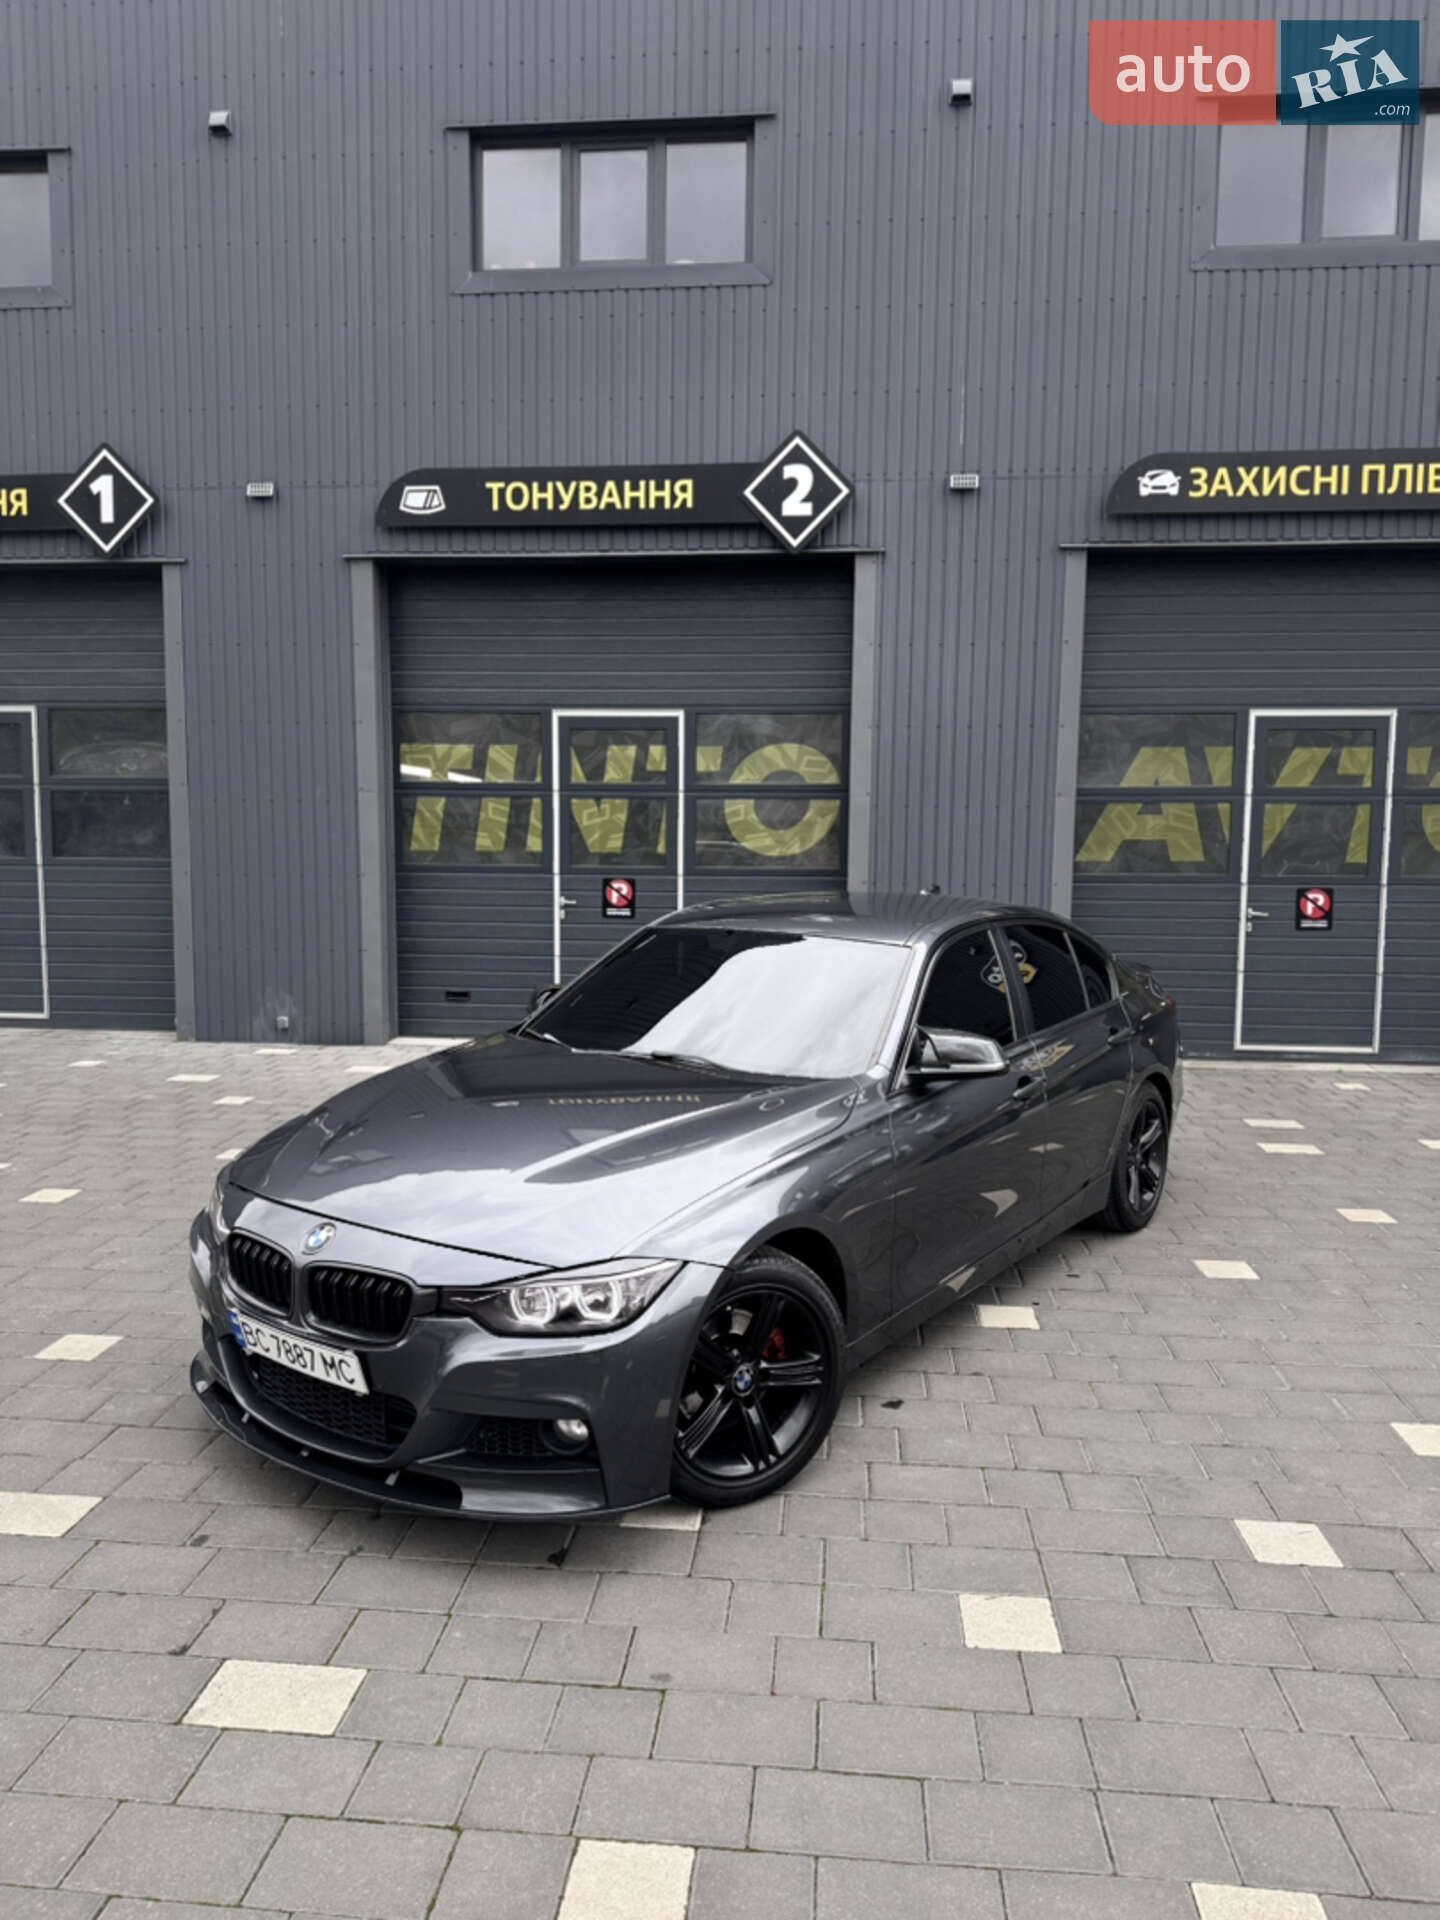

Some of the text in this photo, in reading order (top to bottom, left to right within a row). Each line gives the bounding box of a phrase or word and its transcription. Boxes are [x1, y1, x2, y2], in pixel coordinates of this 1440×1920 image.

[88, 474, 115, 524] 1
[484, 478, 694, 512] ТОНУВАННЯ
[781, 463, 814, 517] 2
[1188, 464, 1350, 498] ЗАХИСНІ
[241, 1321, 356, 1385] BC 7887 MC
